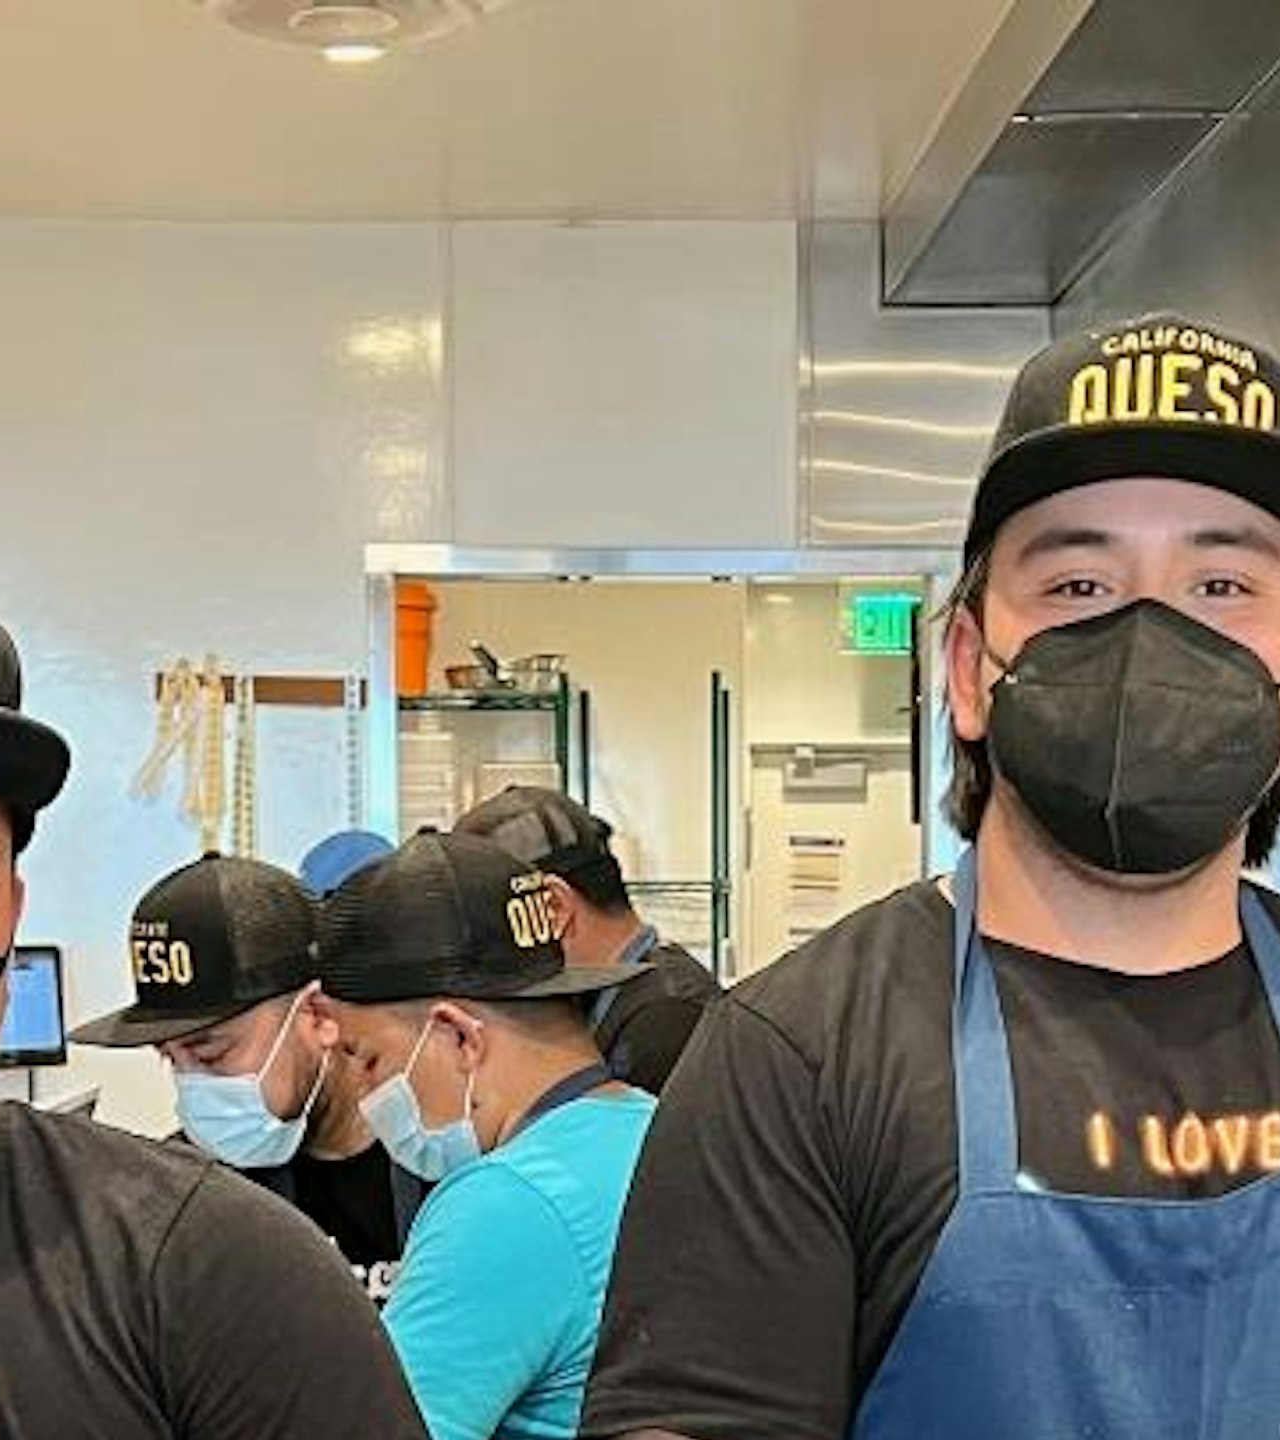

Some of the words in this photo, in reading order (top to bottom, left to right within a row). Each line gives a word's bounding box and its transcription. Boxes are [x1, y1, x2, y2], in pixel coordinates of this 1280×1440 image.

[1101, 326, 1257, 372] CALIFORNIA
[1069, 353, 1275, 429] QUESO
[1087, 1111, 1114, 1168] I
